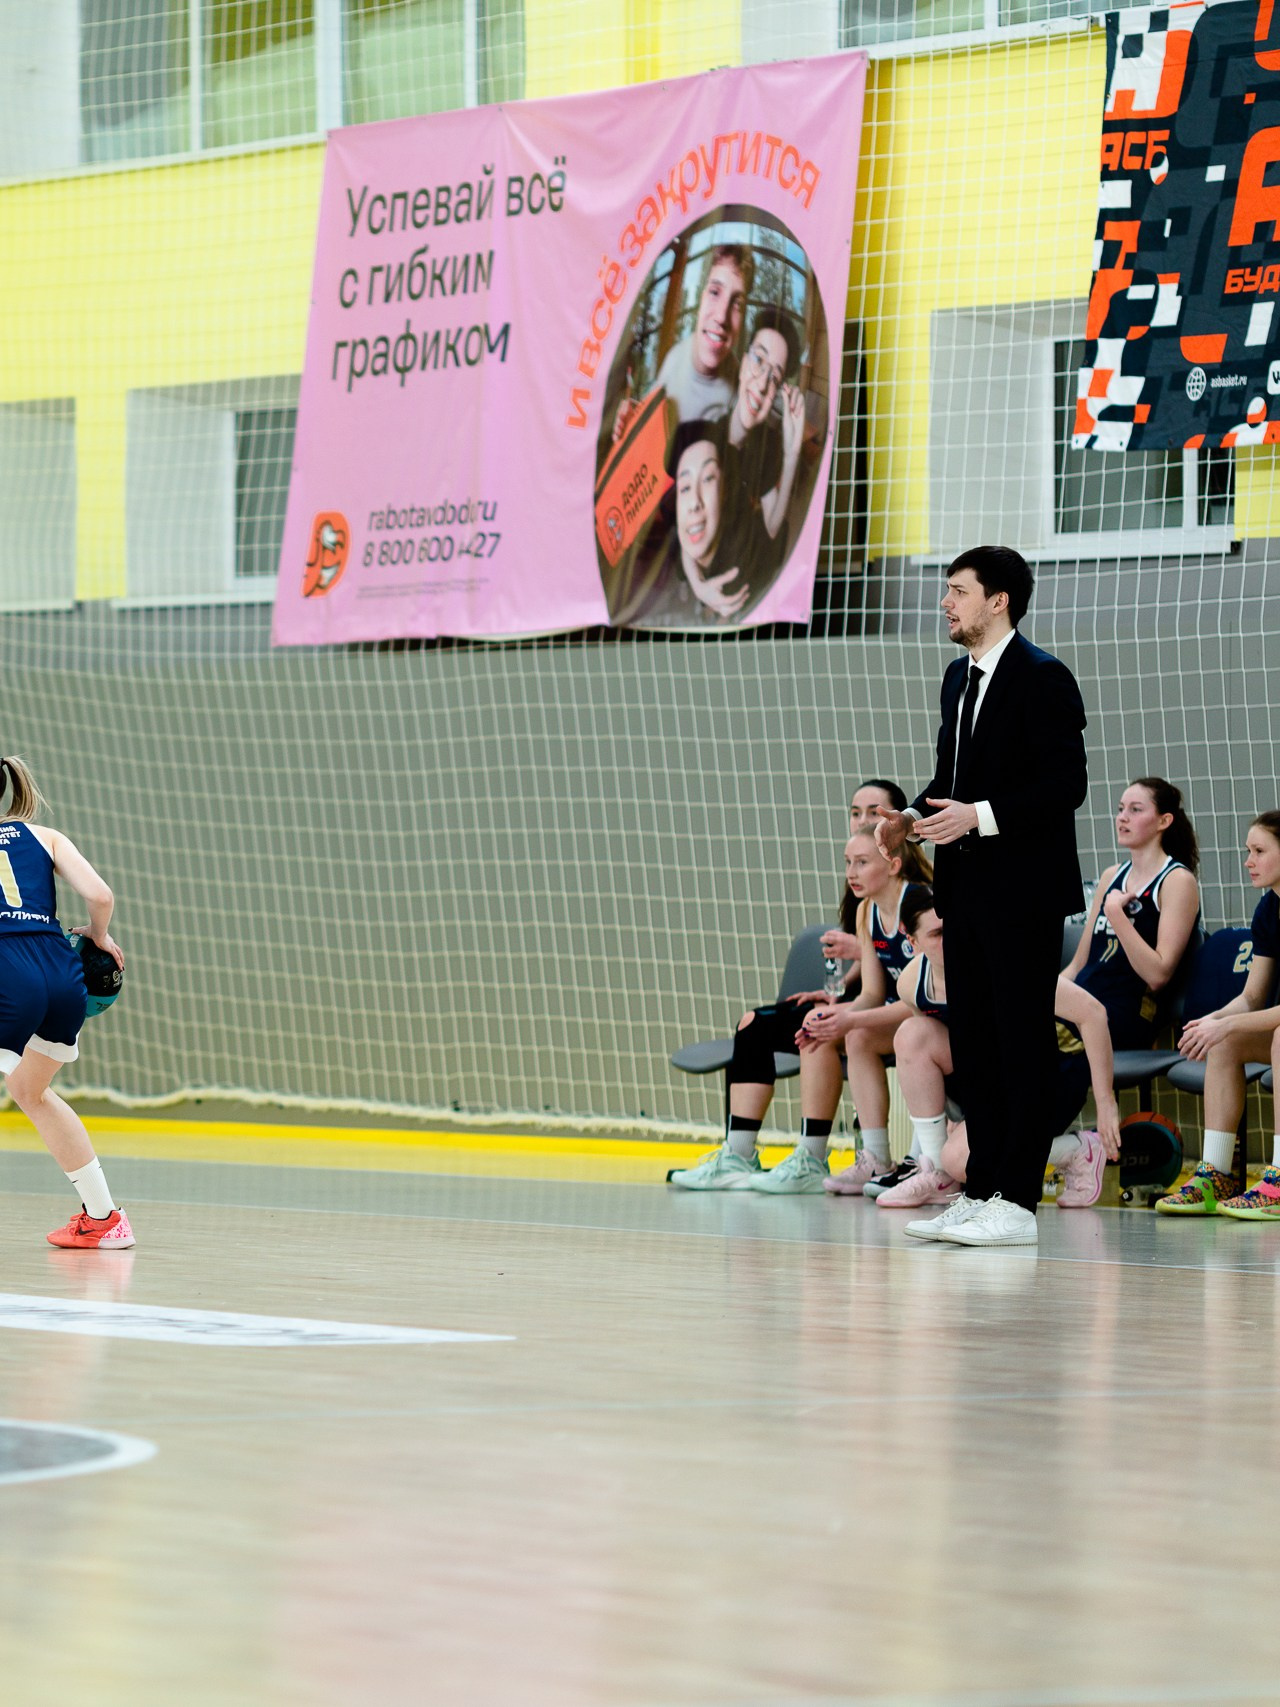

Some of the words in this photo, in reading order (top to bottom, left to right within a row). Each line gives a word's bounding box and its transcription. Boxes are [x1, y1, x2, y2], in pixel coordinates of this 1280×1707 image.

[1101, 129, 1170, 172] АСБ
[347, 163, 495, 238] Успевай
[506, 156, 566, 217] всё
[620, 131, 821, 268] закрутится
[340, 268, 358, 309] с
[368, 244, 494, 305] гибким
[576, 255, 628, 380] всё
[332, 319, 511, 393] графиком
[568, 388, 591, 429] и
[622, 464, 648, 509] ДОДО
[626, 474, 658, 524] ПИЦЦА
[363, 542, 374, 567] 8
[378, 539, 415, 566] 800
[418, 536, 454, 563] 600
